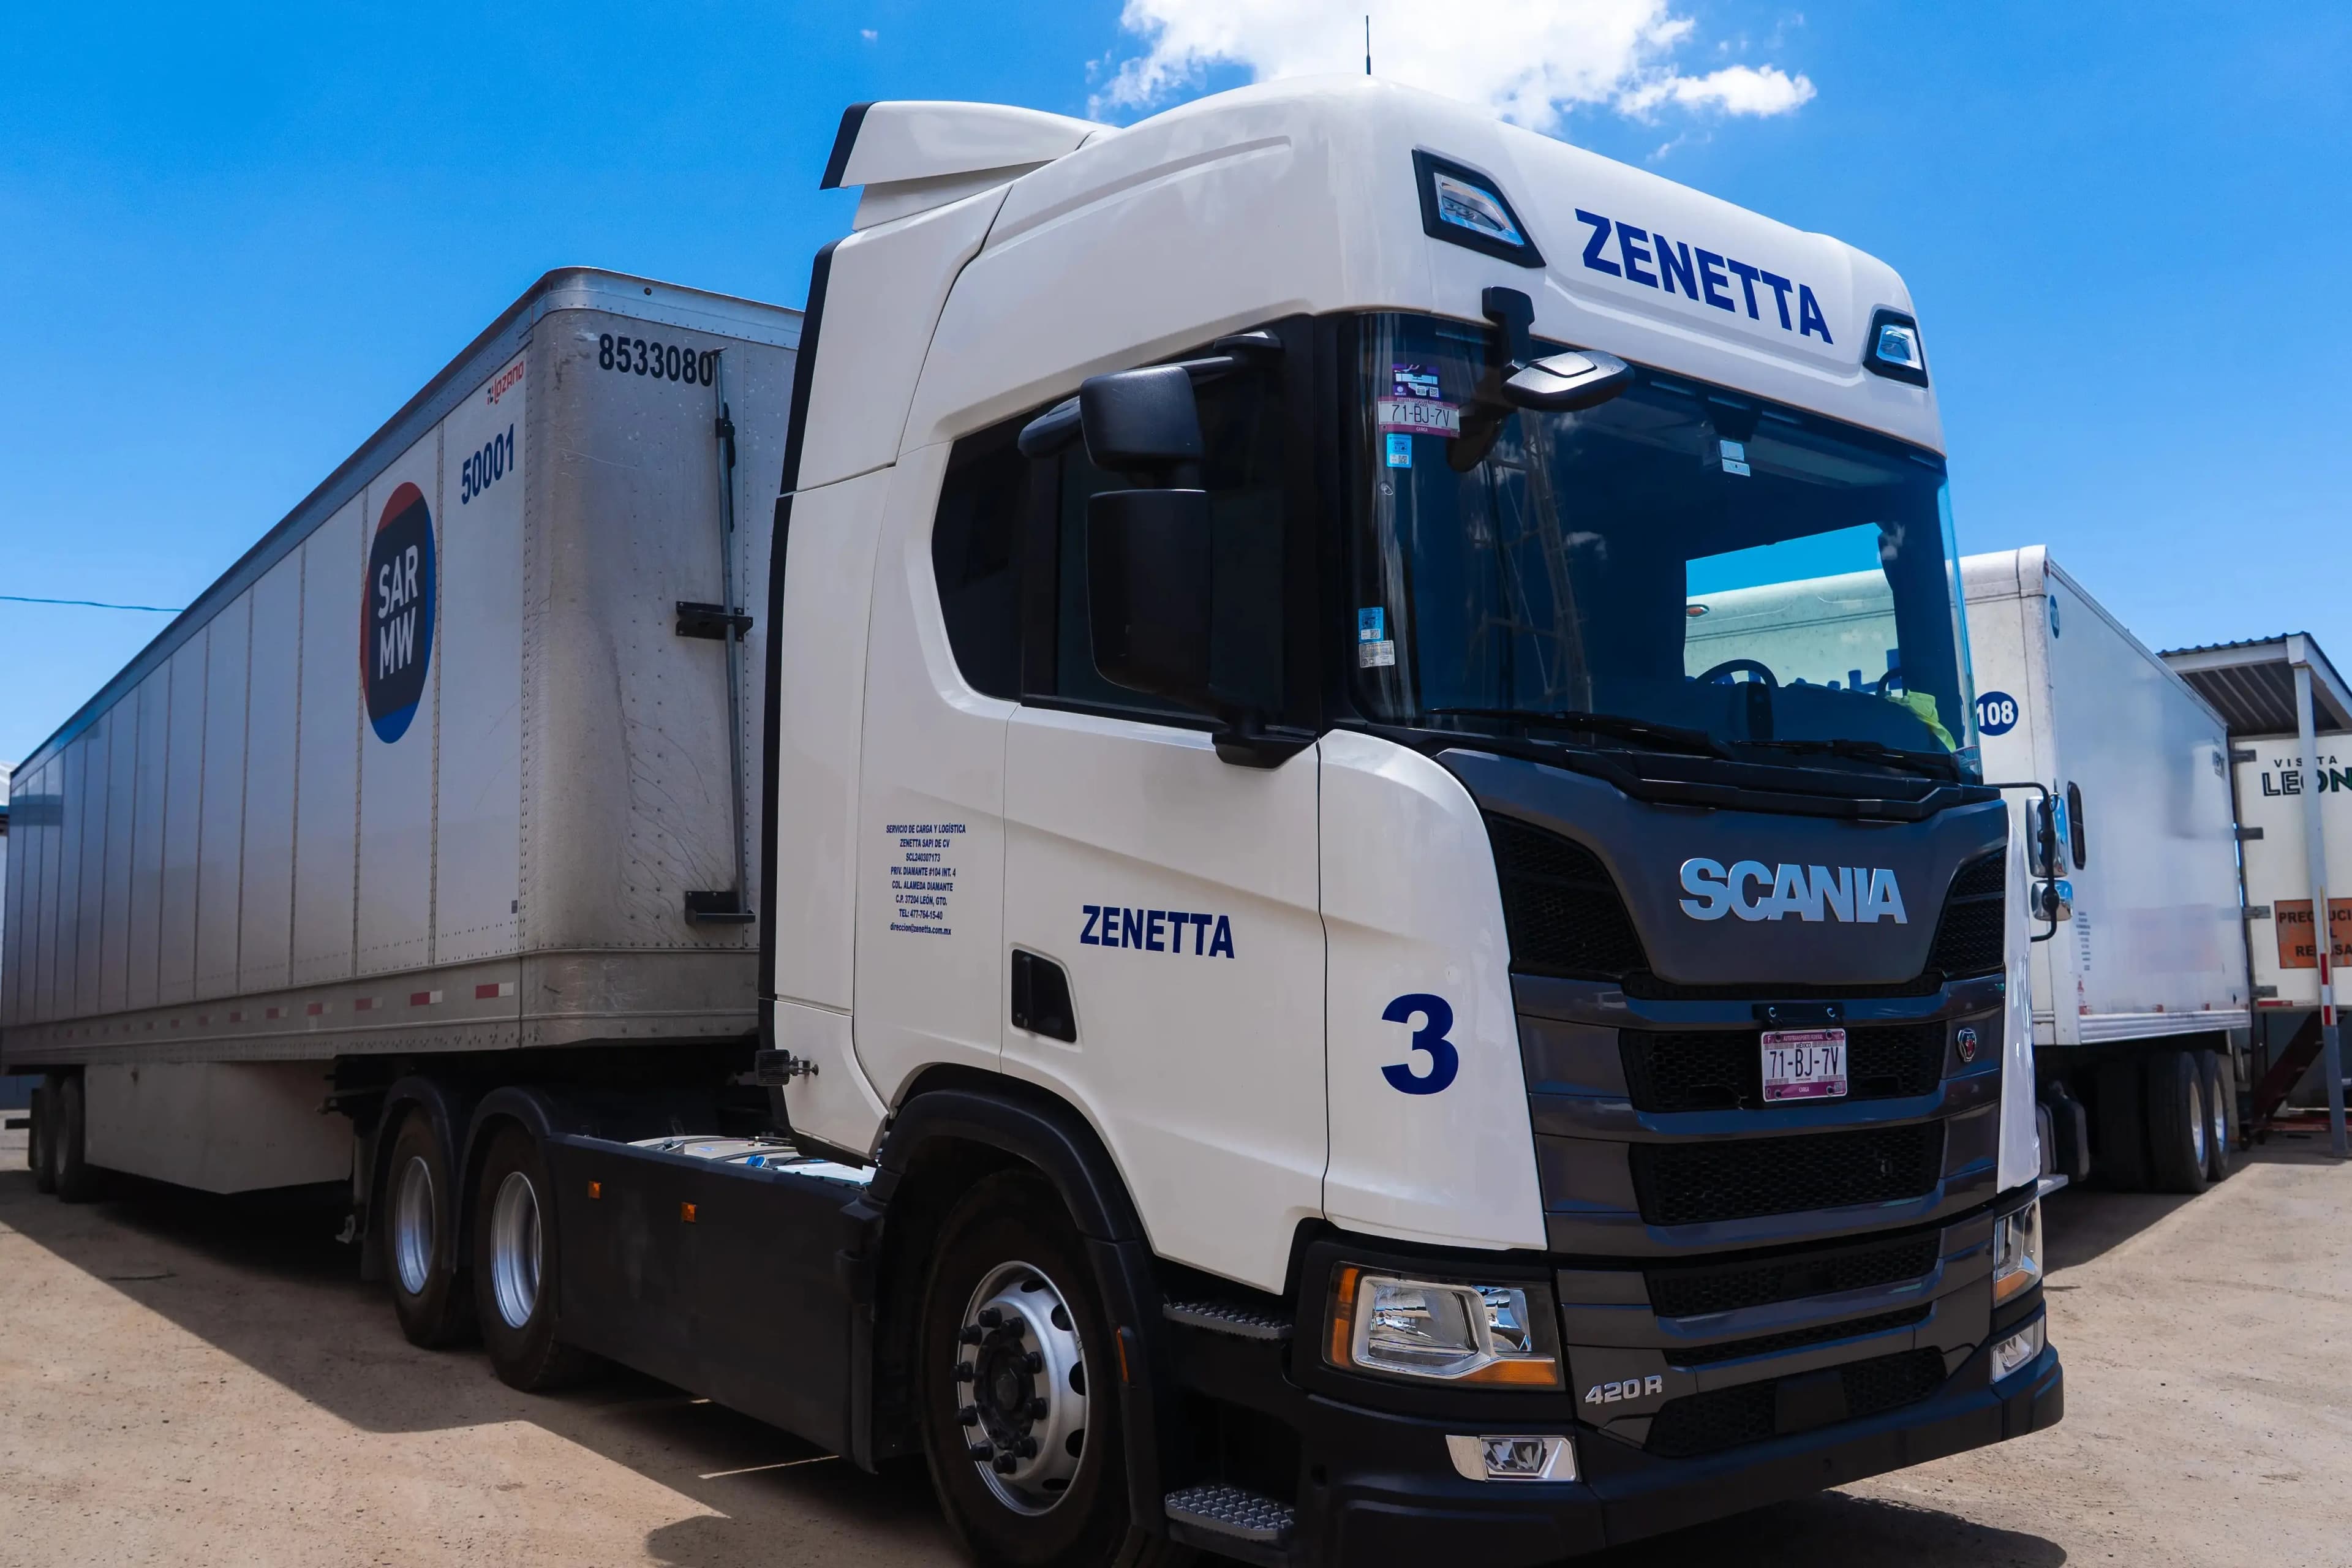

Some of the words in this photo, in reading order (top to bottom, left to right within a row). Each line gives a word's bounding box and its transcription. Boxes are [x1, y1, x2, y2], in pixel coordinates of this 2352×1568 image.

[1575, 208, 1834, 344] ZENETTA
[599, 334, 713, 386] 8533080
[1392, 405, 1449, 426] 71-BJ-7V
[462, 423, 514, 505] 50001
[379, 545, 418, 619] SAR
[379, 608, 417, 679] MW
[1977, 701, 2014, 726] 108
[2274, 755, 2337, 767] VISTA
[886, 824, 907, 834] SERVICIO
[909, 824, 915, 833] DE
[916, 824, 932, 833] CARGA
[934, 824, 938, 833] Y
[939, 823, 966, 833] LOGÍSTICA
[900, 839, 921, 847] ZENETTA
[922, 839, 933, 848] SAPI
[935, 839, 941, 848] DE
[943, 839, 950, 848] CV
[891, 867, 902, 875] PRIV.
[903, 867, 928, 876] DIAMANTE
[929, 867, 941, 876] #104
[942, 868, 951, 876] INT.
[952, 868, 956, 877] 4
[903, 881, 925, 890] ALAMEDA
[927, 882, 953, 891] DIAMANTE
[895, 894, 904, 903] C.P.
[905, 895, 919, 904] 37204
[936, 897, 948, 905] GTO.
[1678, 858, 1908, 924] SCANIA
[899, 909, 909, 918] TEL:
[910, 910, 943, 920] 477-764-15-40
[1080, 905, 1235, 959] ZENETTA
[1381, 993, 1459, 1095] 3
[1770, 1047, 1839, 1079] 71-BJ-7V
[1585, 1379, 1640, 1404] 420
[1645, 1375, 1662, 1395] R
